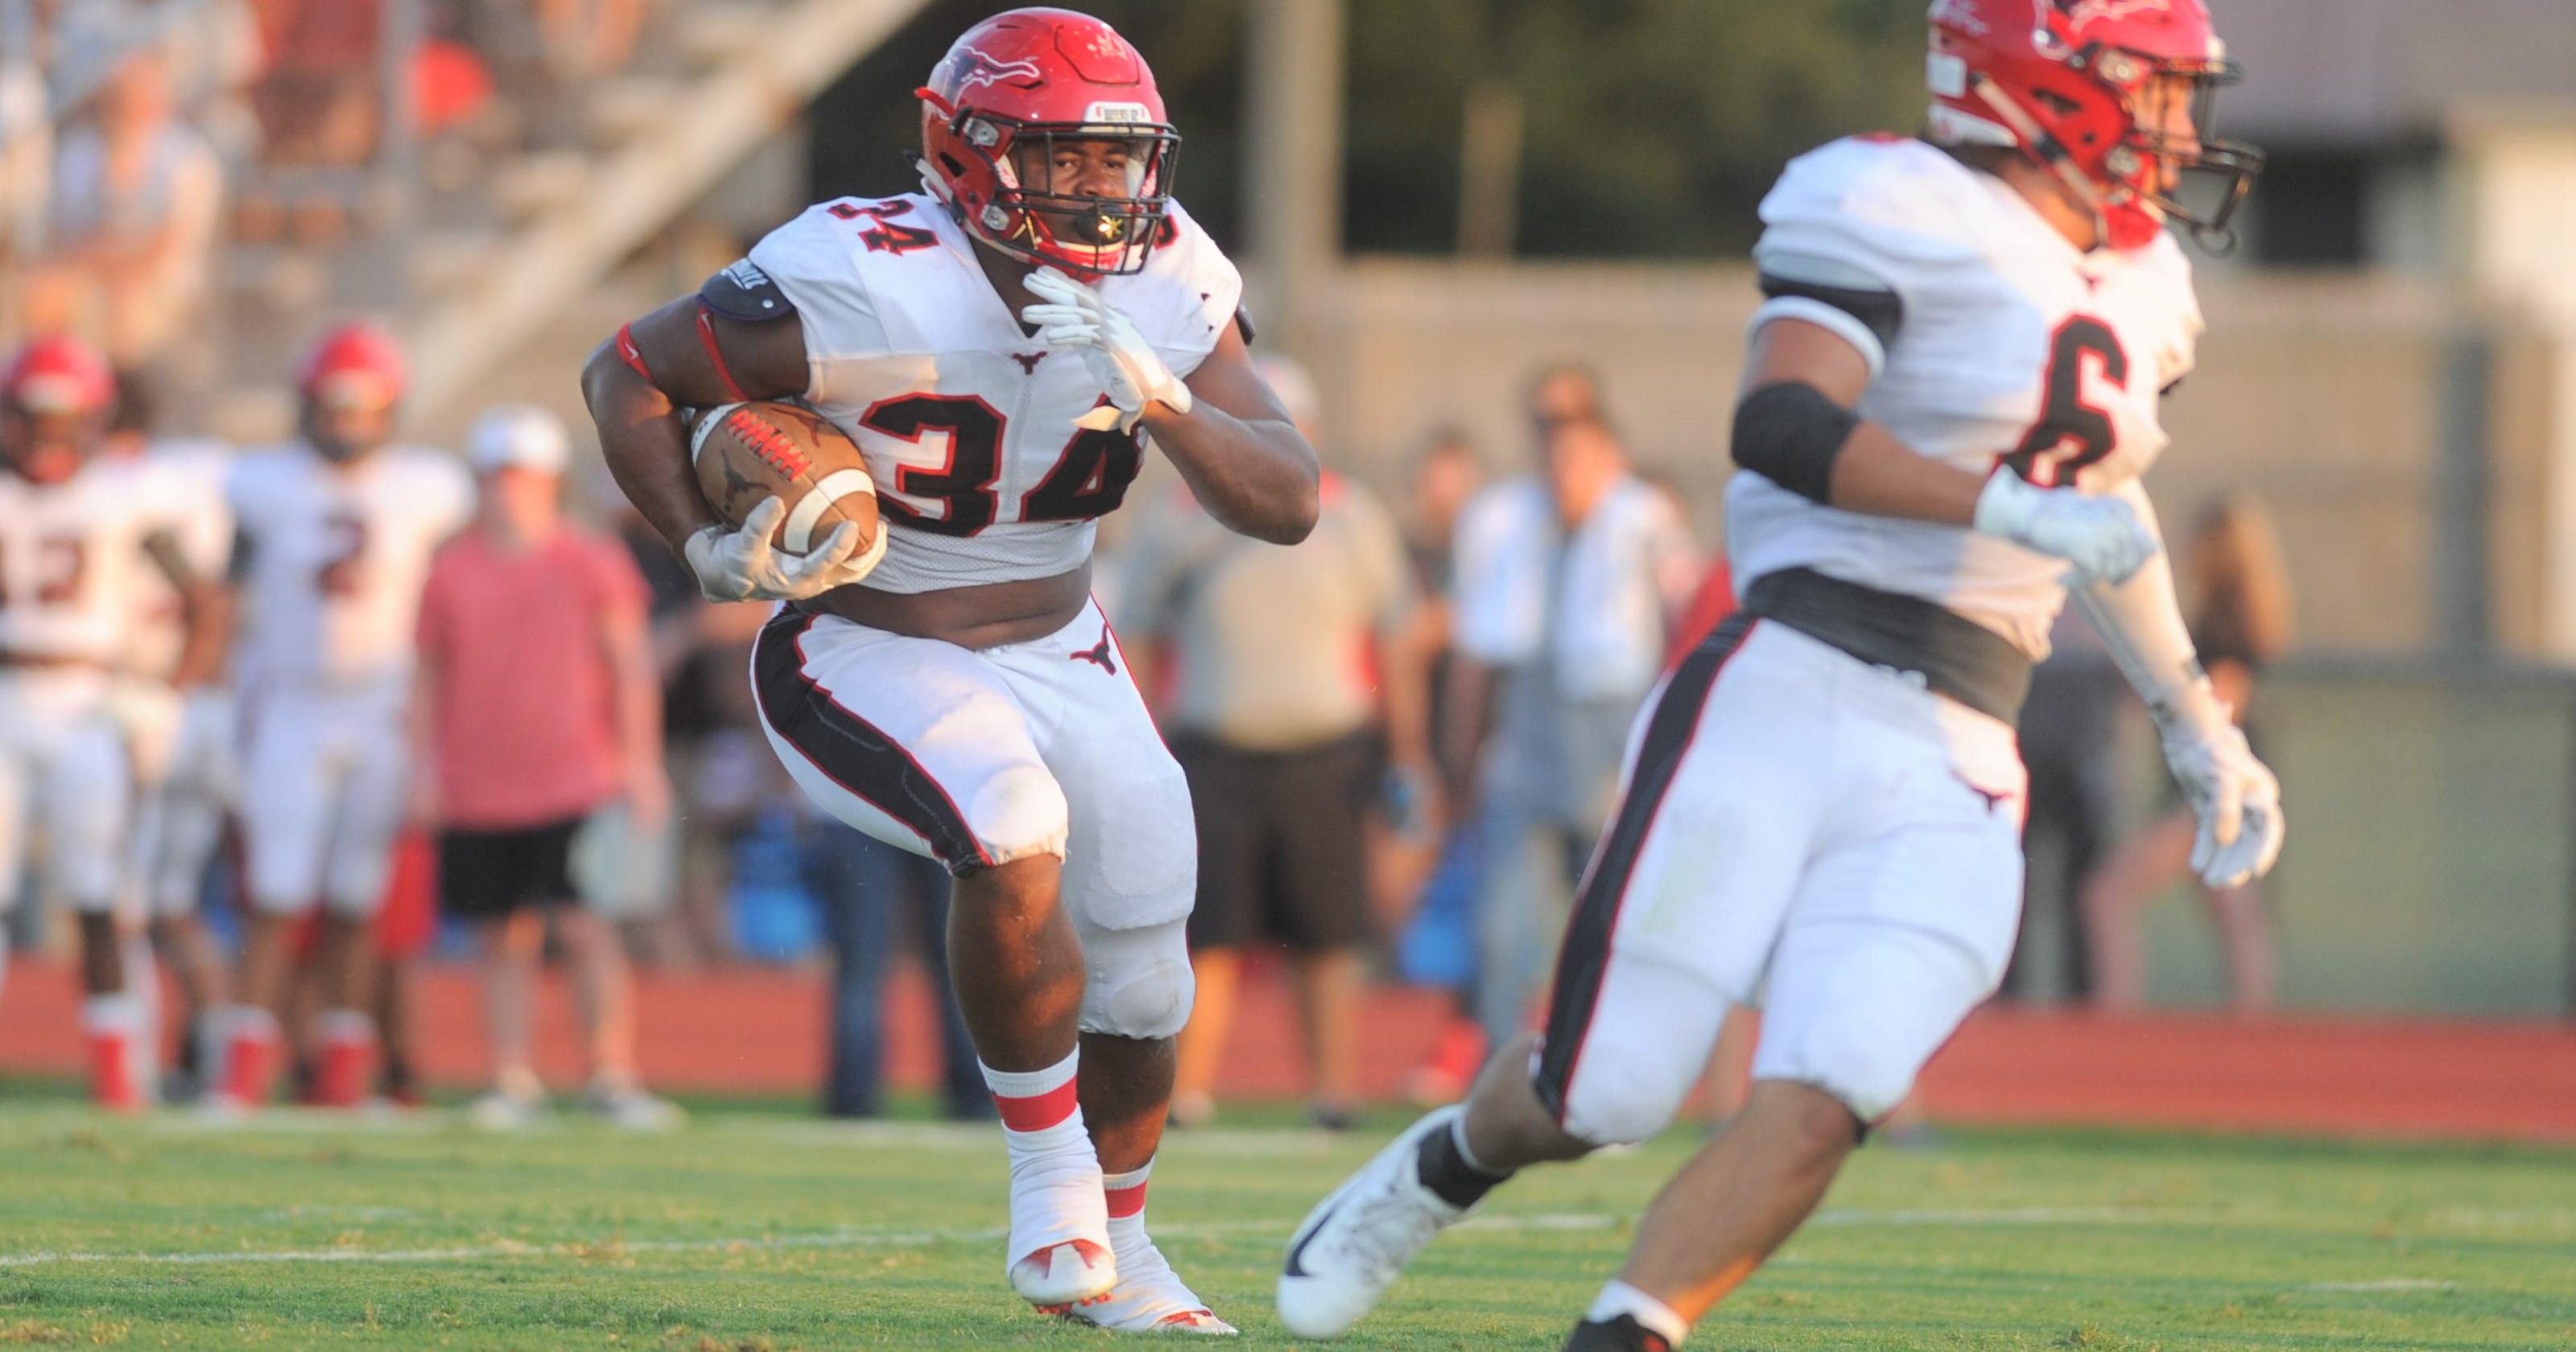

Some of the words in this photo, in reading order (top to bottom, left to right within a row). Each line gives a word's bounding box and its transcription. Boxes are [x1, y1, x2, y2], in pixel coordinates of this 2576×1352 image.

[827, 199, 940, 256] 34
[858, 392, 1142, 538] 34
[1988, 314, 2128, 489] 6
